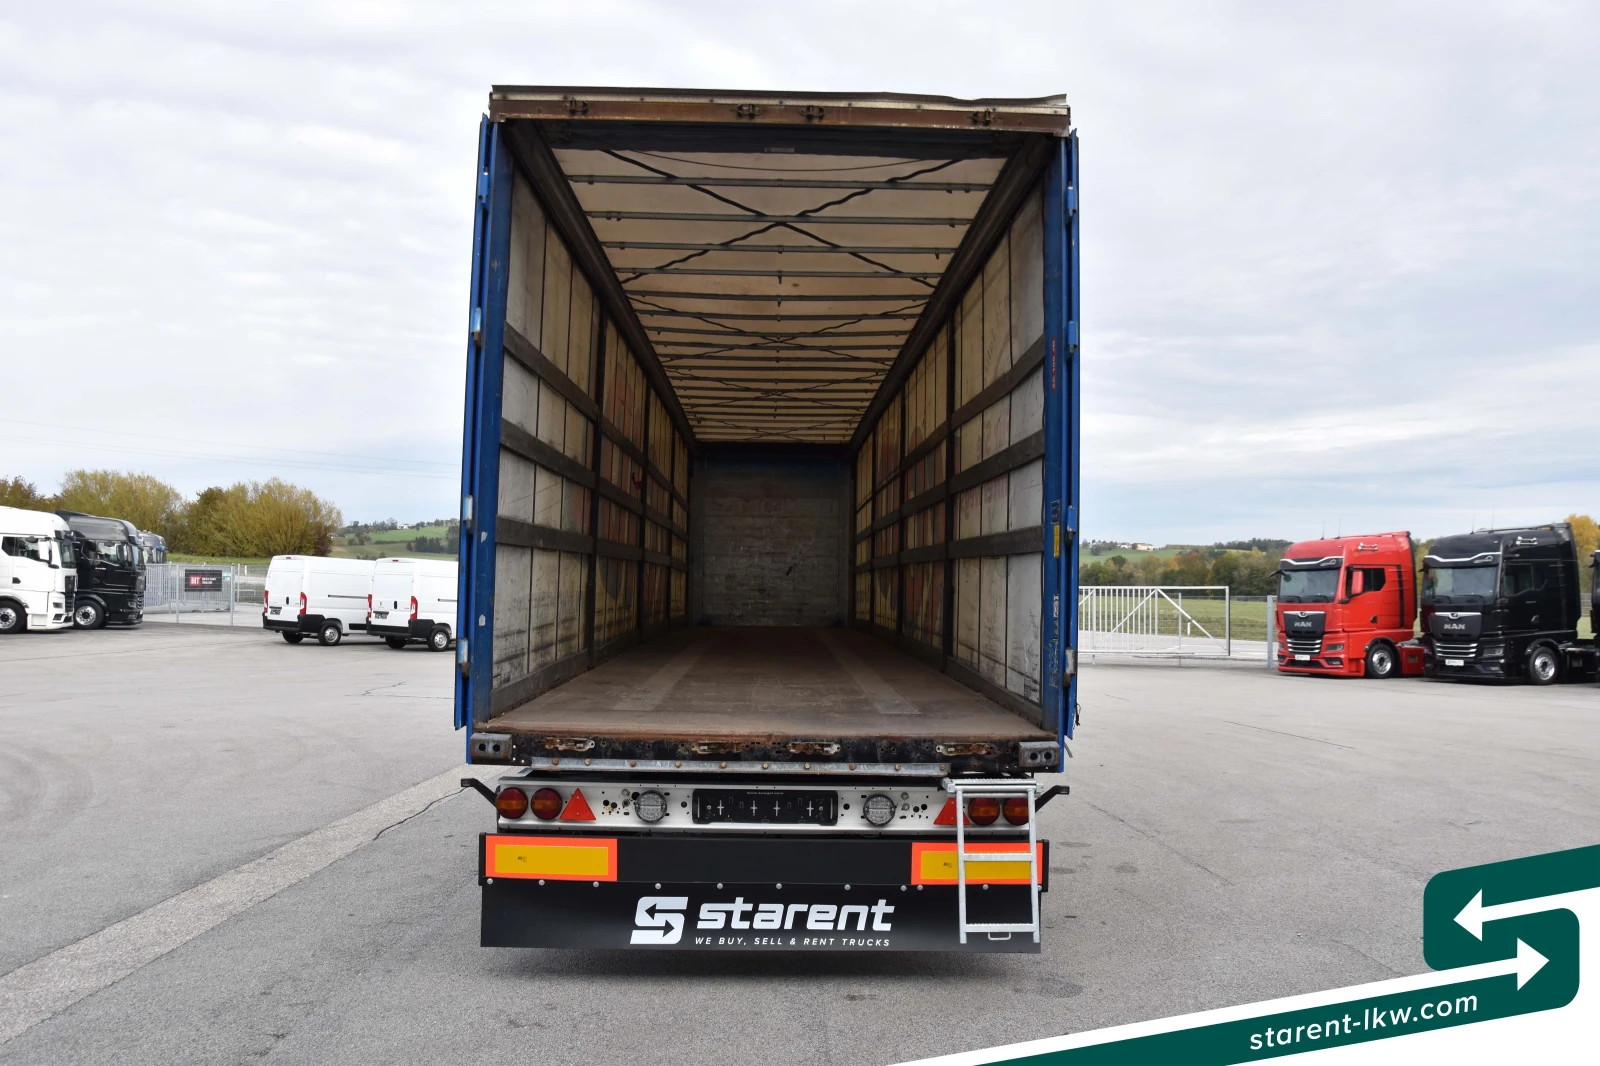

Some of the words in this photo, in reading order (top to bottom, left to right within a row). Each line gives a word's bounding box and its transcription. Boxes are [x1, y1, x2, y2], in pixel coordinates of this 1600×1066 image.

[191, 577, 200, 585] BIT
[697, 897, 895, 931] starent
[695, 937, 712, 945] WE
[718, 937, 747, 946] BUY,
[754, 938, 783, 946] SELL
[789, 938, 797, 946] &
[803, 938, 835, 946] RENT
[841, 939, 890, 947] TRUCKS
